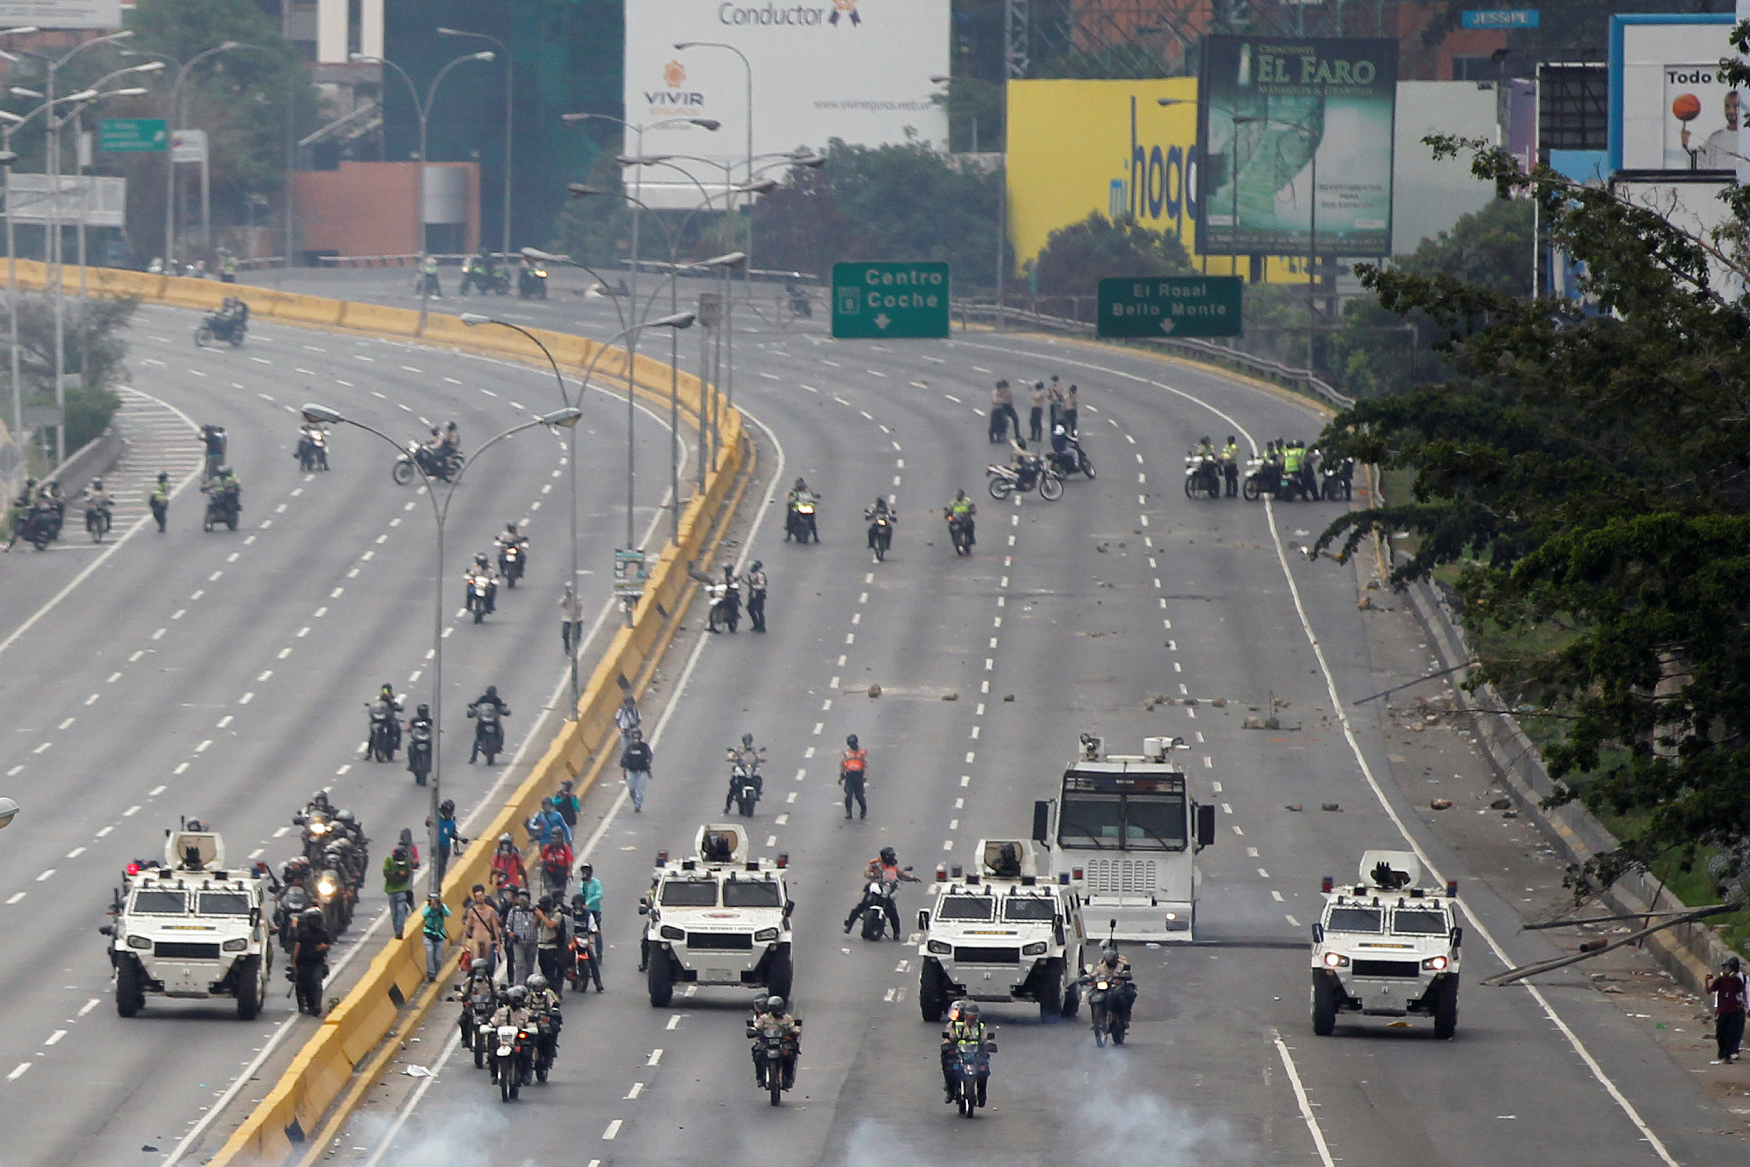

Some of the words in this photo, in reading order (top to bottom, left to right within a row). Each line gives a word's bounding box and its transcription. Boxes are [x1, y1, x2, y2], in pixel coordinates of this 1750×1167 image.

[718, 2, 826, 26] Conductor
[1257, 54, 1291, 83] EL
[1300, 56, 1376, 84] FARO
[1667, 70, 1712, 84] Todo
[644, 92, 705, 106] VIVIR
[866, 269, 942, 286] Centro
[1133, 283, 1150, 298] El
[1159, 283, 1207, 297] Rosal
[868, 291, 938, 308] Coche
[1113, 302, 1160, 316] Bello
[1172, 302, 1227, 316] Monte
